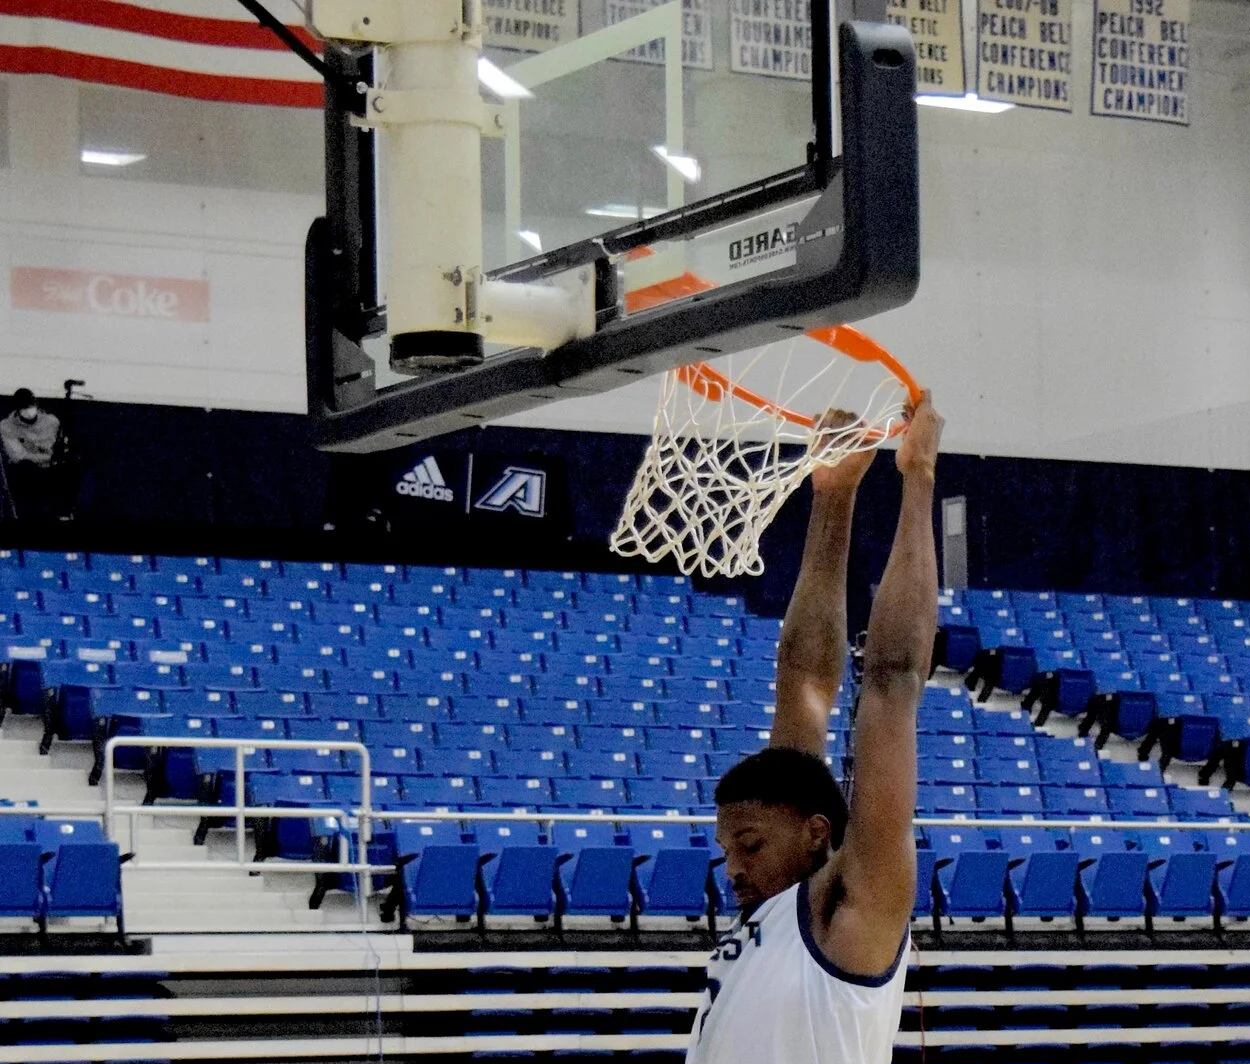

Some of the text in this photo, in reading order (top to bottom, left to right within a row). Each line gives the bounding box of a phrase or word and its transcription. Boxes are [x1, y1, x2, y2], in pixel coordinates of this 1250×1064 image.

[981, 12, 1026, 40] PEACH
[1099, 12, 1145, 38] PEACH
[988, 70, 1068, 101] CHAMPIONS
[1104, 87, 1185, 119] CHAMPIONS
[88, 275, 179, 317] Coke
[395, 481, 454, 502] adidas
